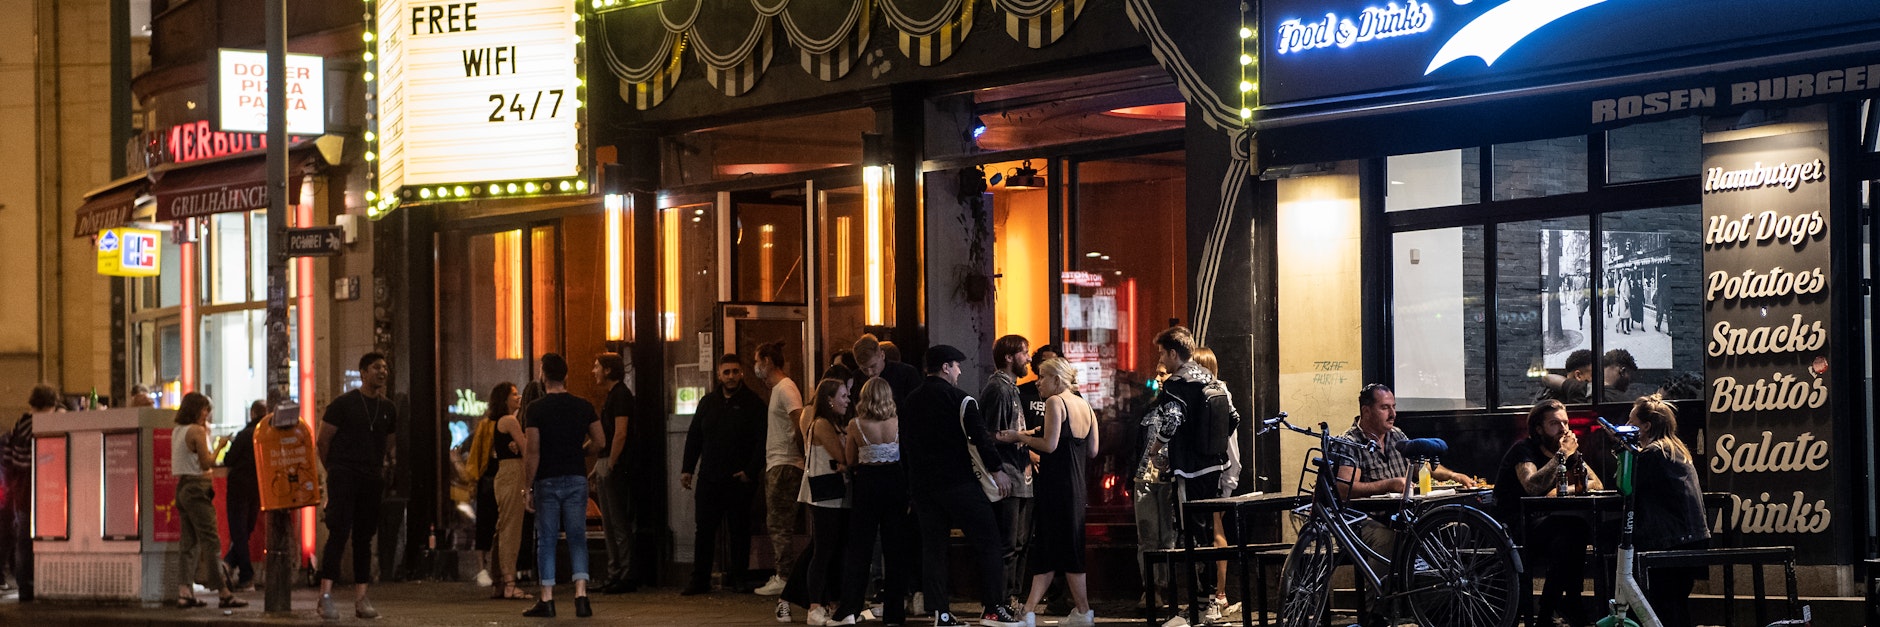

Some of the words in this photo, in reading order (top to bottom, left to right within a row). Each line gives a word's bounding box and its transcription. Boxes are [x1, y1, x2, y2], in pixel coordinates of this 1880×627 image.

[411, 2, 478, 35] FREE
[1277, 13, 1335, 53] Food
[1335, 19, 1357, 48] &
[1357, 0, 1433, 42] Drinks
[234, 63, 310, 79] DOER
[462, 45, 516, 77] WIFI
[239, 95, 307, 111] PATA
[241, 79, 303, 95] PIA
[488, 89, 564, 122] 24/7
[1591, 87, 1716, 124] ROSEN
[1704, 157, 1826, 194] Hamburger
[1705, 213, 1753, 247] Hot
[1755, 208, 1827, 247] Dogs
[1707, 267, 1827, 302] Potatoes
[1708, 313, 1828, 358] Snacks
[1709, 371, 1829, 414] Buritos
[1710, 431, 1830, 475] Salate
[1624, 510, 1635, 534] Lime
